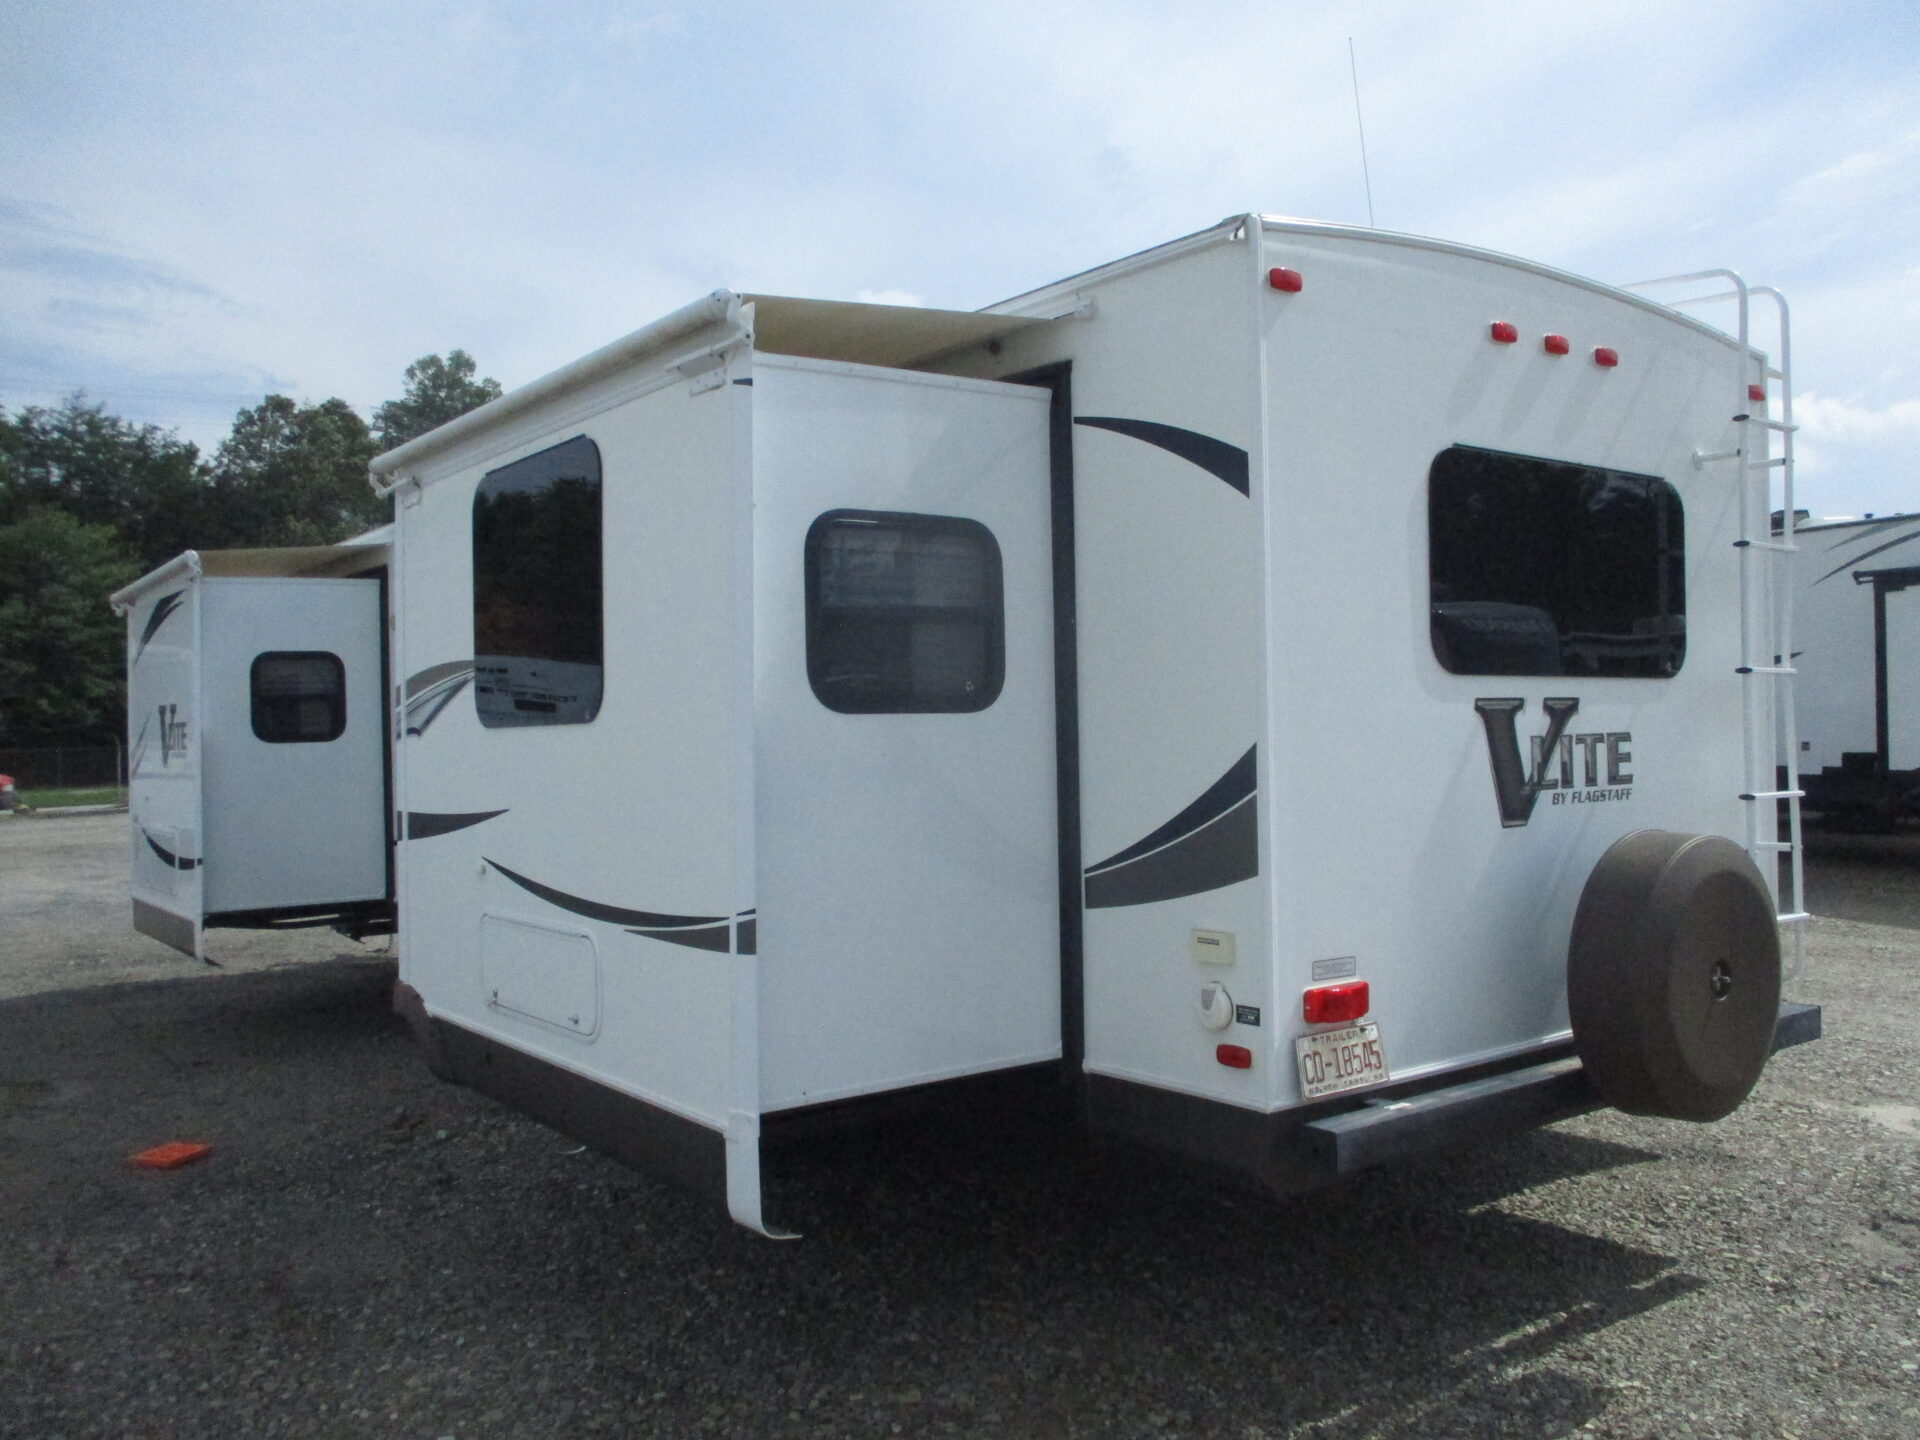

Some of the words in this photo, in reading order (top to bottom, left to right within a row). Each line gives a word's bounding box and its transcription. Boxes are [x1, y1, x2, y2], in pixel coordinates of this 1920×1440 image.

[1552, 792, 1568, 805] BY
[1571, 788, 1633, 804] FLAGSTAFF
[1319, 1029, 1359, 1045] TRAILER
[1303, 1039, 1382, 1084] CD-18545
